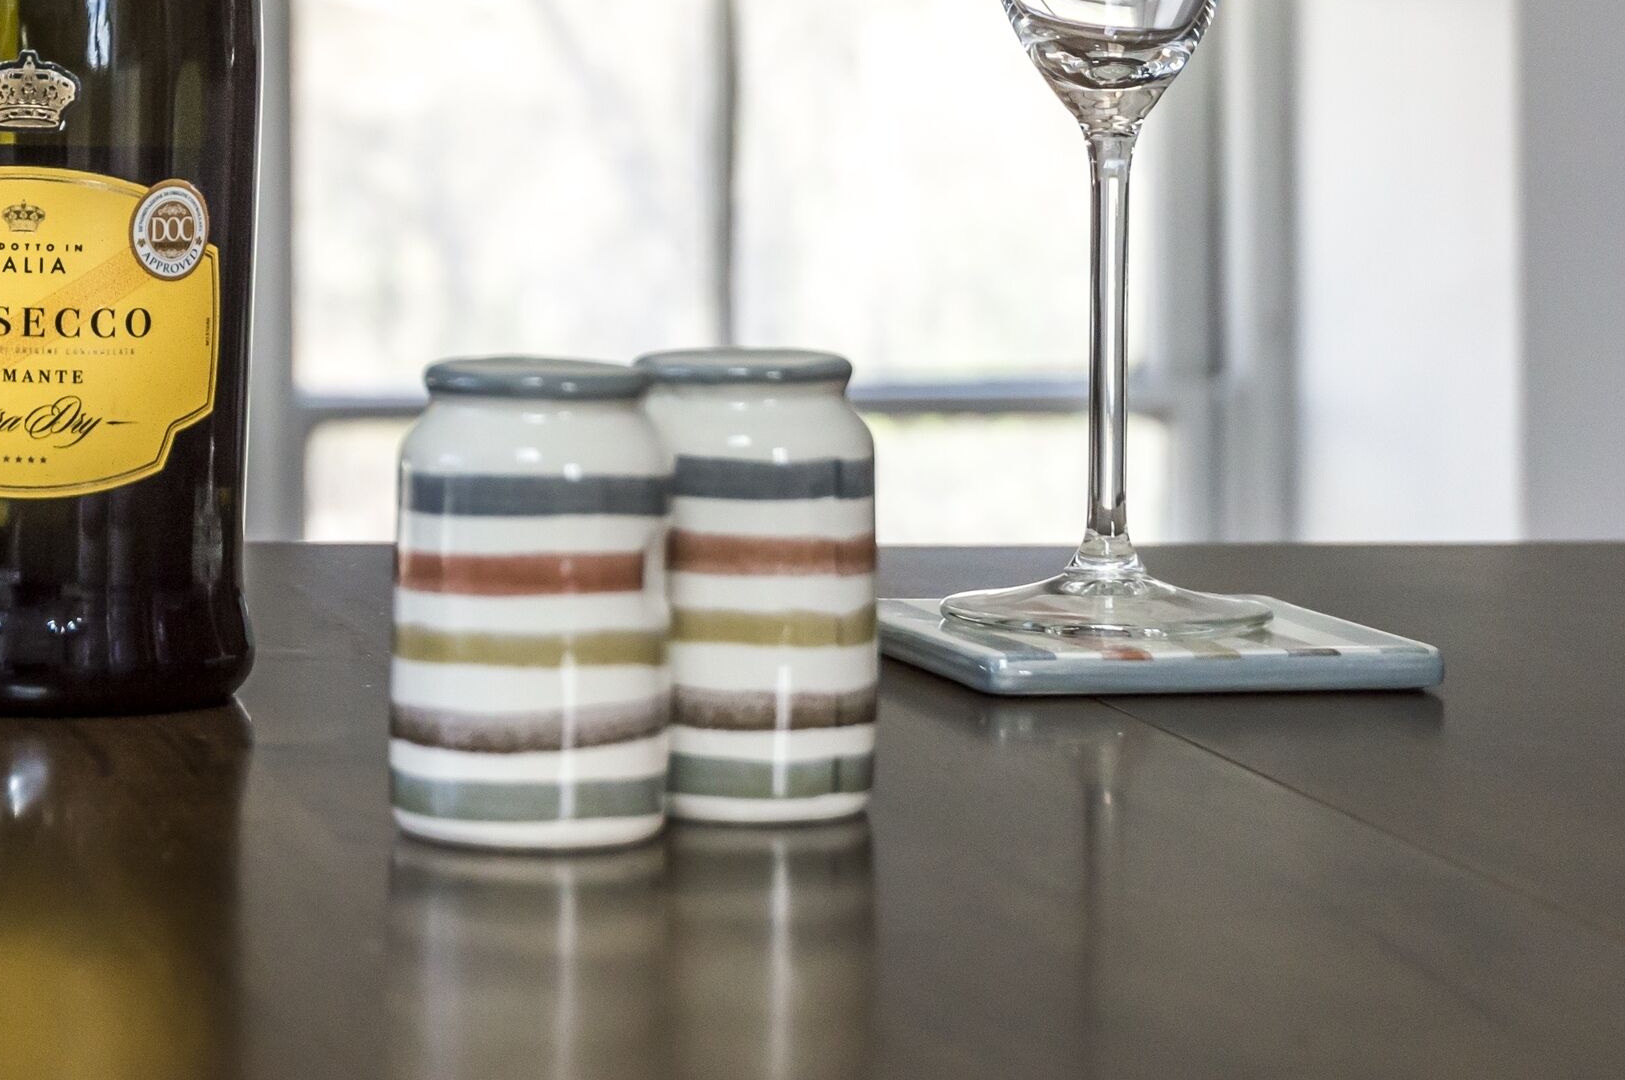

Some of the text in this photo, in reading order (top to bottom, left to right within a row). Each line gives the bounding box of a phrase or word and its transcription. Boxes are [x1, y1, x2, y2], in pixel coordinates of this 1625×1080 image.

[151, 216, 193, 242] DOC
[65, 244, 83, 253] IN
[142, 248, 198, 274] APPROVED
[24, 395, 103, 449] Dry
